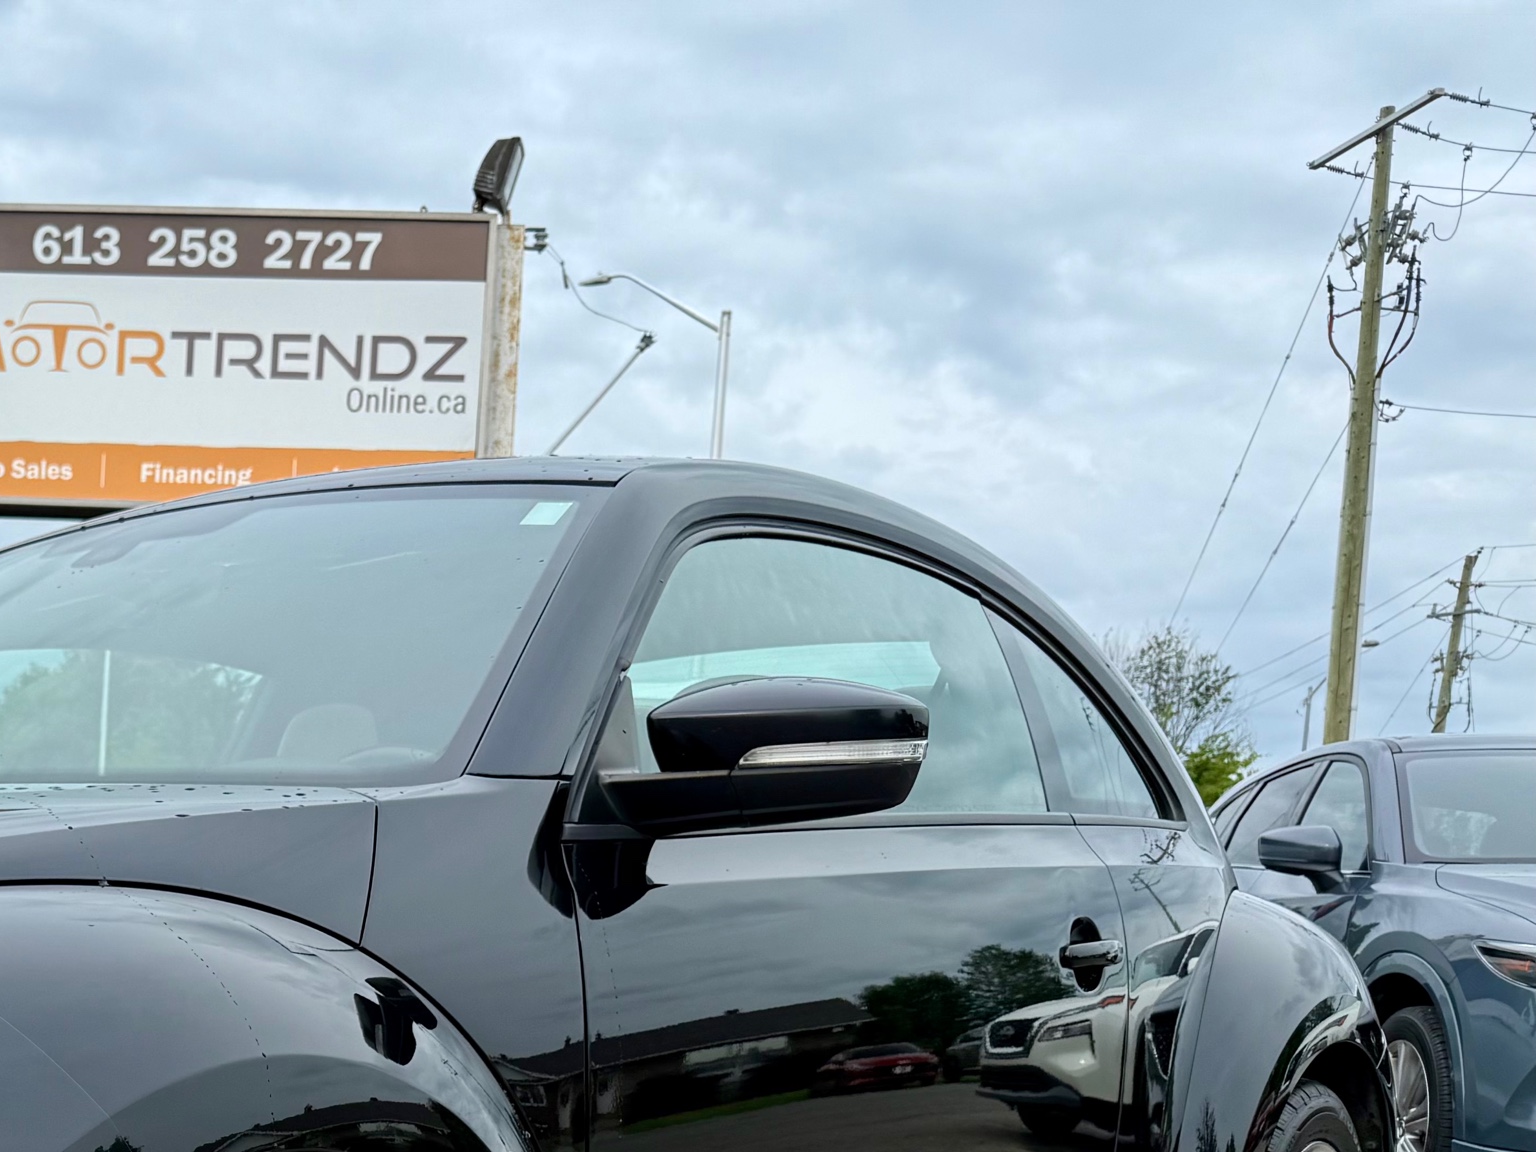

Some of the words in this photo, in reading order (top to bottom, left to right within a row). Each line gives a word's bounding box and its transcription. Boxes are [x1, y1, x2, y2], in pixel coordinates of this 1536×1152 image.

[32, 224, 122, 267] 613
[147, 228, 238, 269] 258
[263, 231, 383, 272] 2727
[346, 386, 467, 415] Online.ca
[10, 457, 73, 482] Sales
[139, 461, 253, 486] Financing
